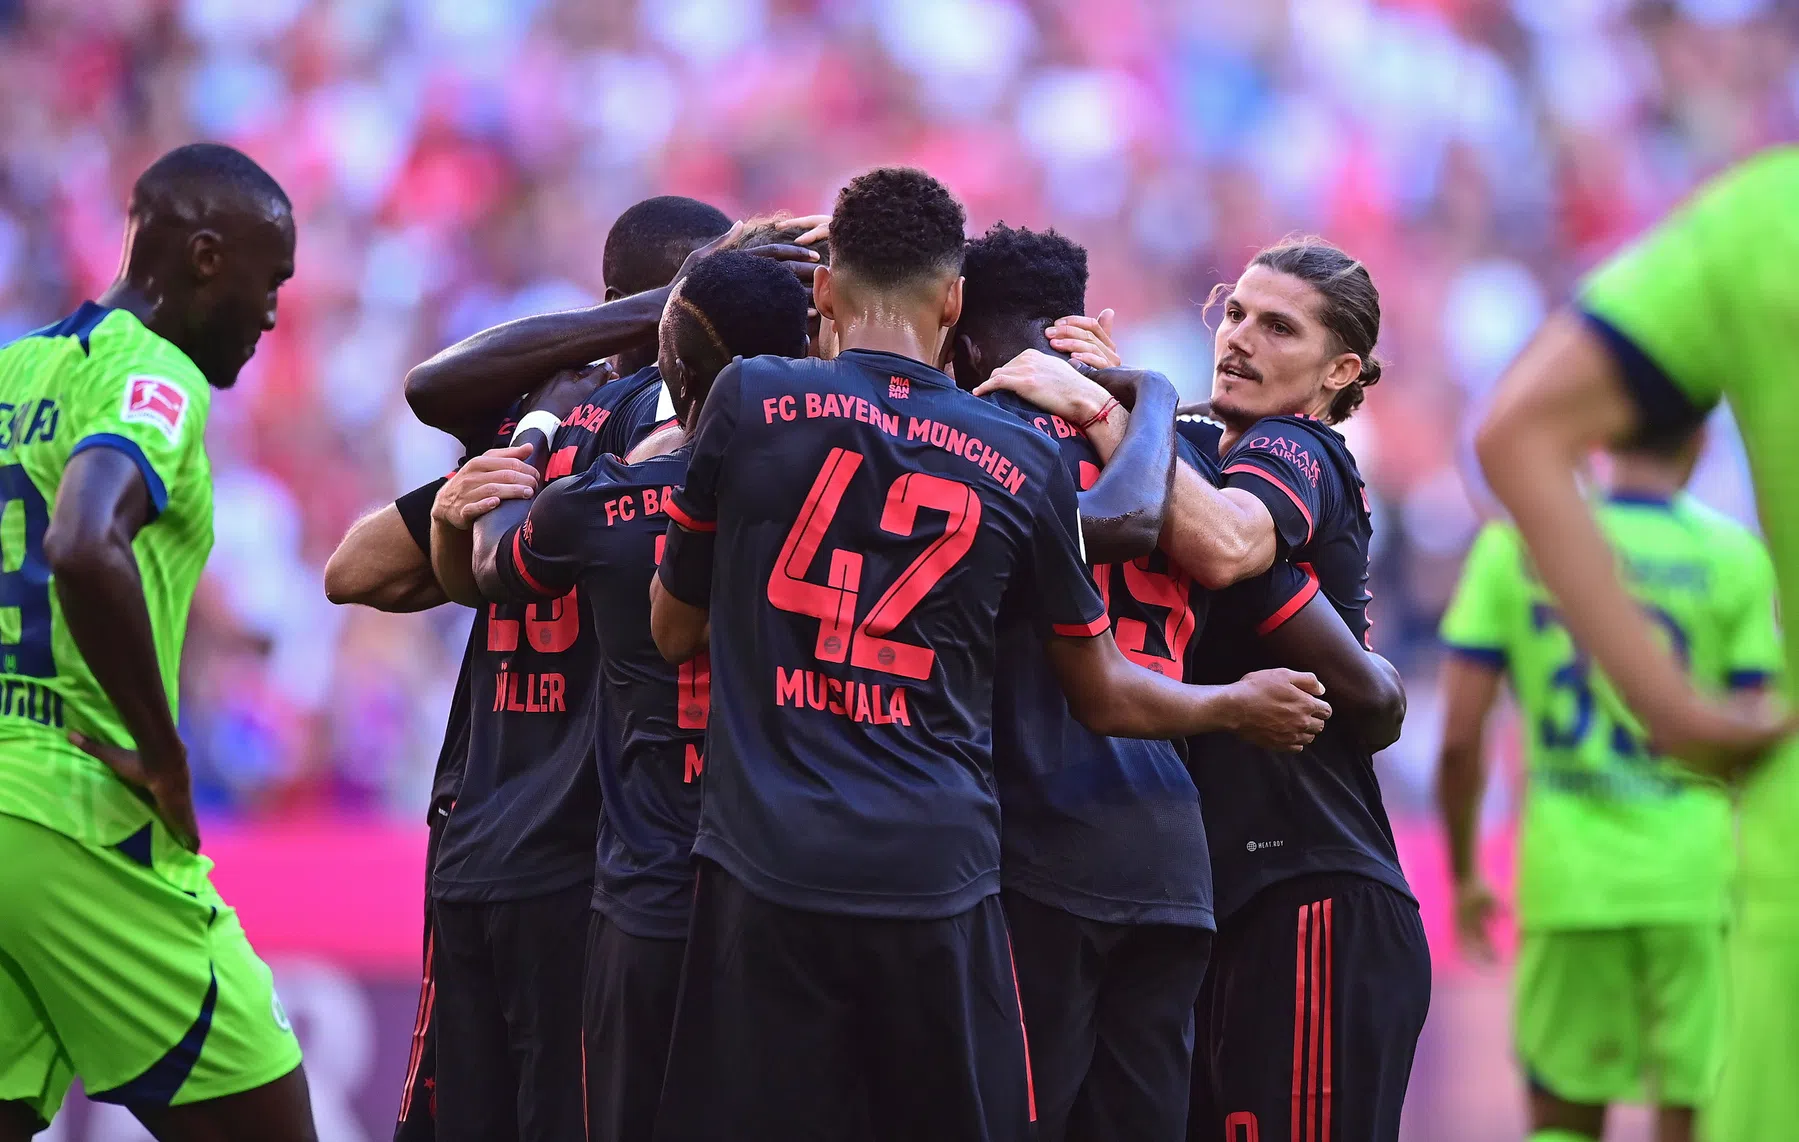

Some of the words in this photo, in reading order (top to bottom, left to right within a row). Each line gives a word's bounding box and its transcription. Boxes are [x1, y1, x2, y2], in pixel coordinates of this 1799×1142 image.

[889, 385, 910, 394] SAN
[890, 375, 909, 387] MIA
[763, 395, 797, 424] FC
[805, 393, 899, 437] BAYERN
[907, 417, 1027, 496] MÜNCHEN
[1249, 436, 1321, 481] QATAR
[1269, 447, 1318, 488] AIRWAYS
[604, 495, 636, 527] FC
[766, 446, 982, 681] 42
[776, 666, 911, 727] MUSIALA
